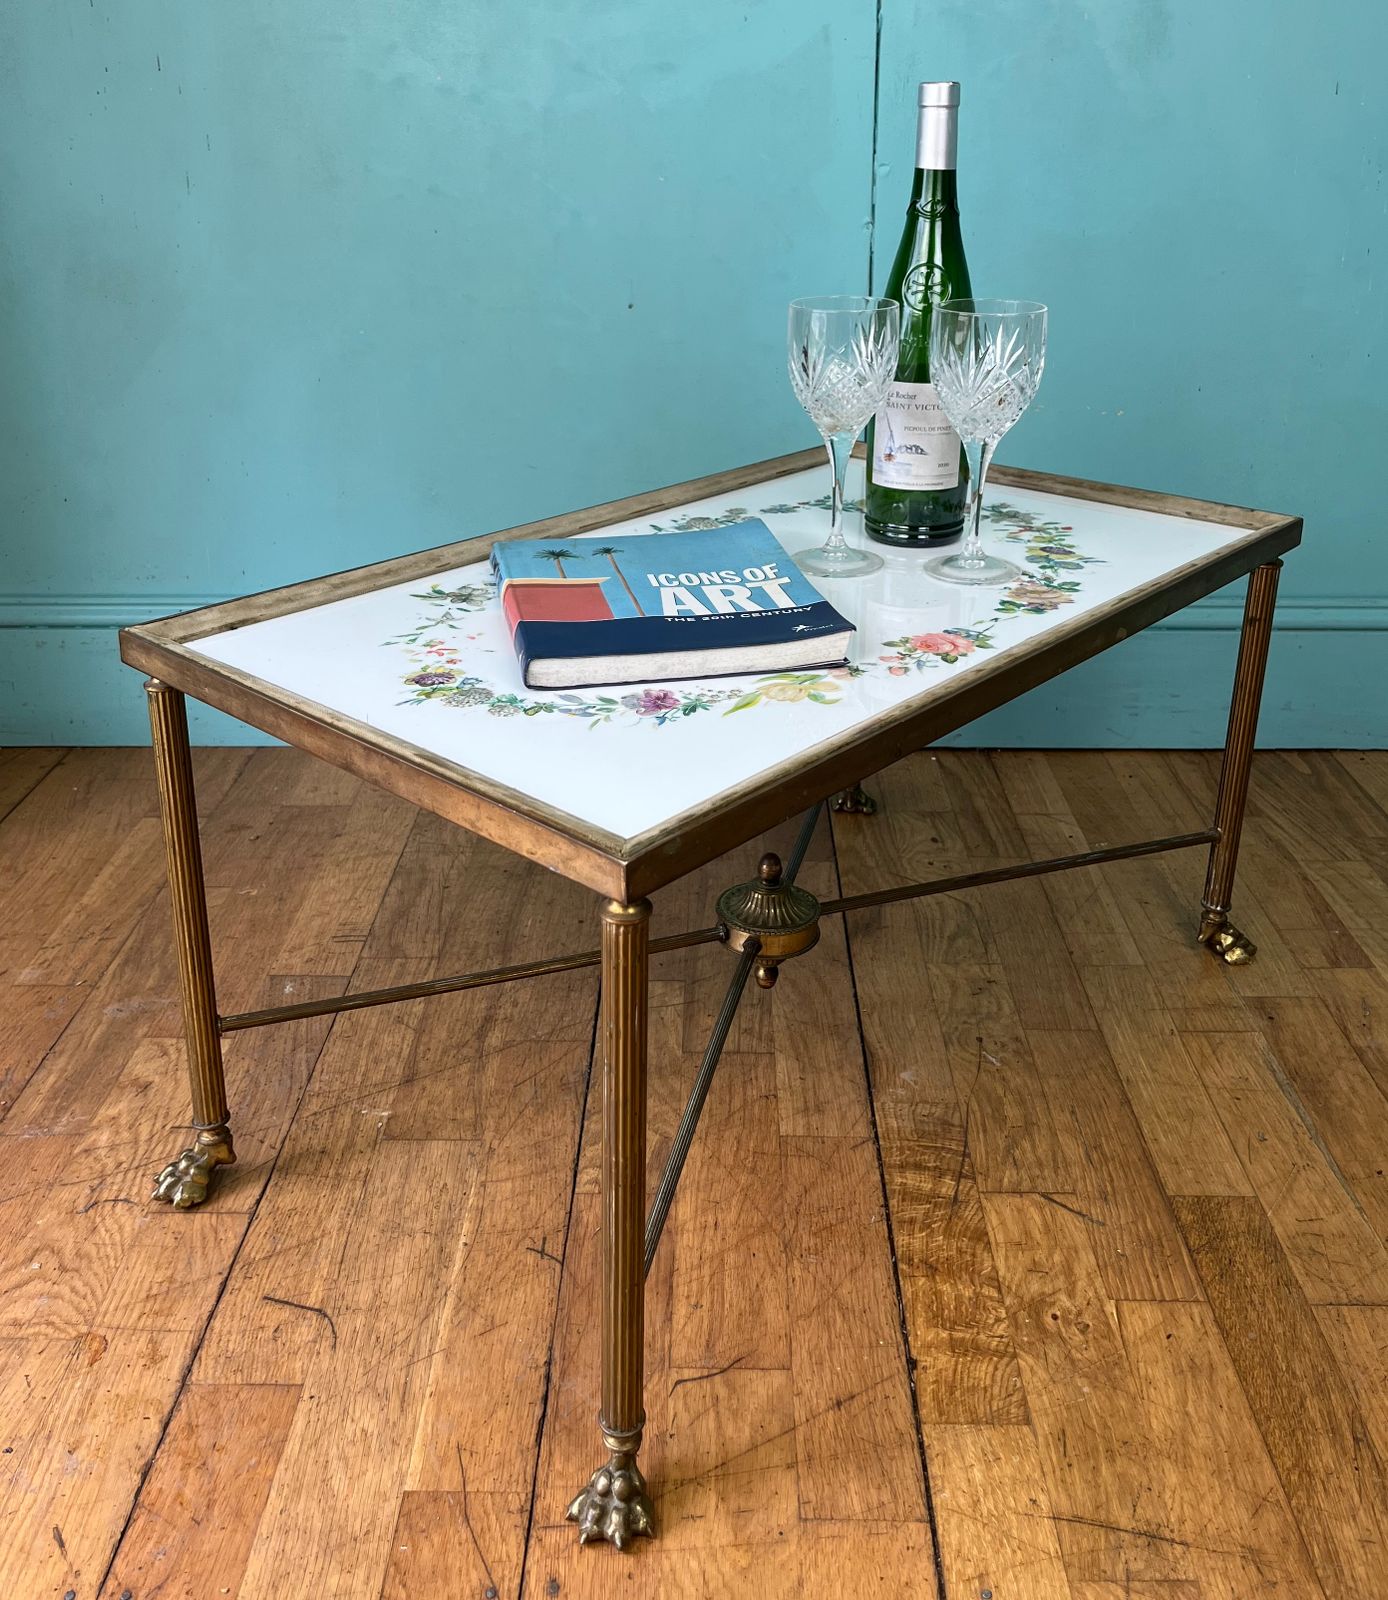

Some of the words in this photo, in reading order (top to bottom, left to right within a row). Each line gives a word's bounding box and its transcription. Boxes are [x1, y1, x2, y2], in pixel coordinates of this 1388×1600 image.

[895, 391, 918, 400] Rocher
[886, 401, 911, 410] SAINT
[647, 569, 742, 587] ICONS
[742, 562, 779, 581] OF
[660, 576, 797, 617] ART
[740, 606, 813, 618] CENTURY
